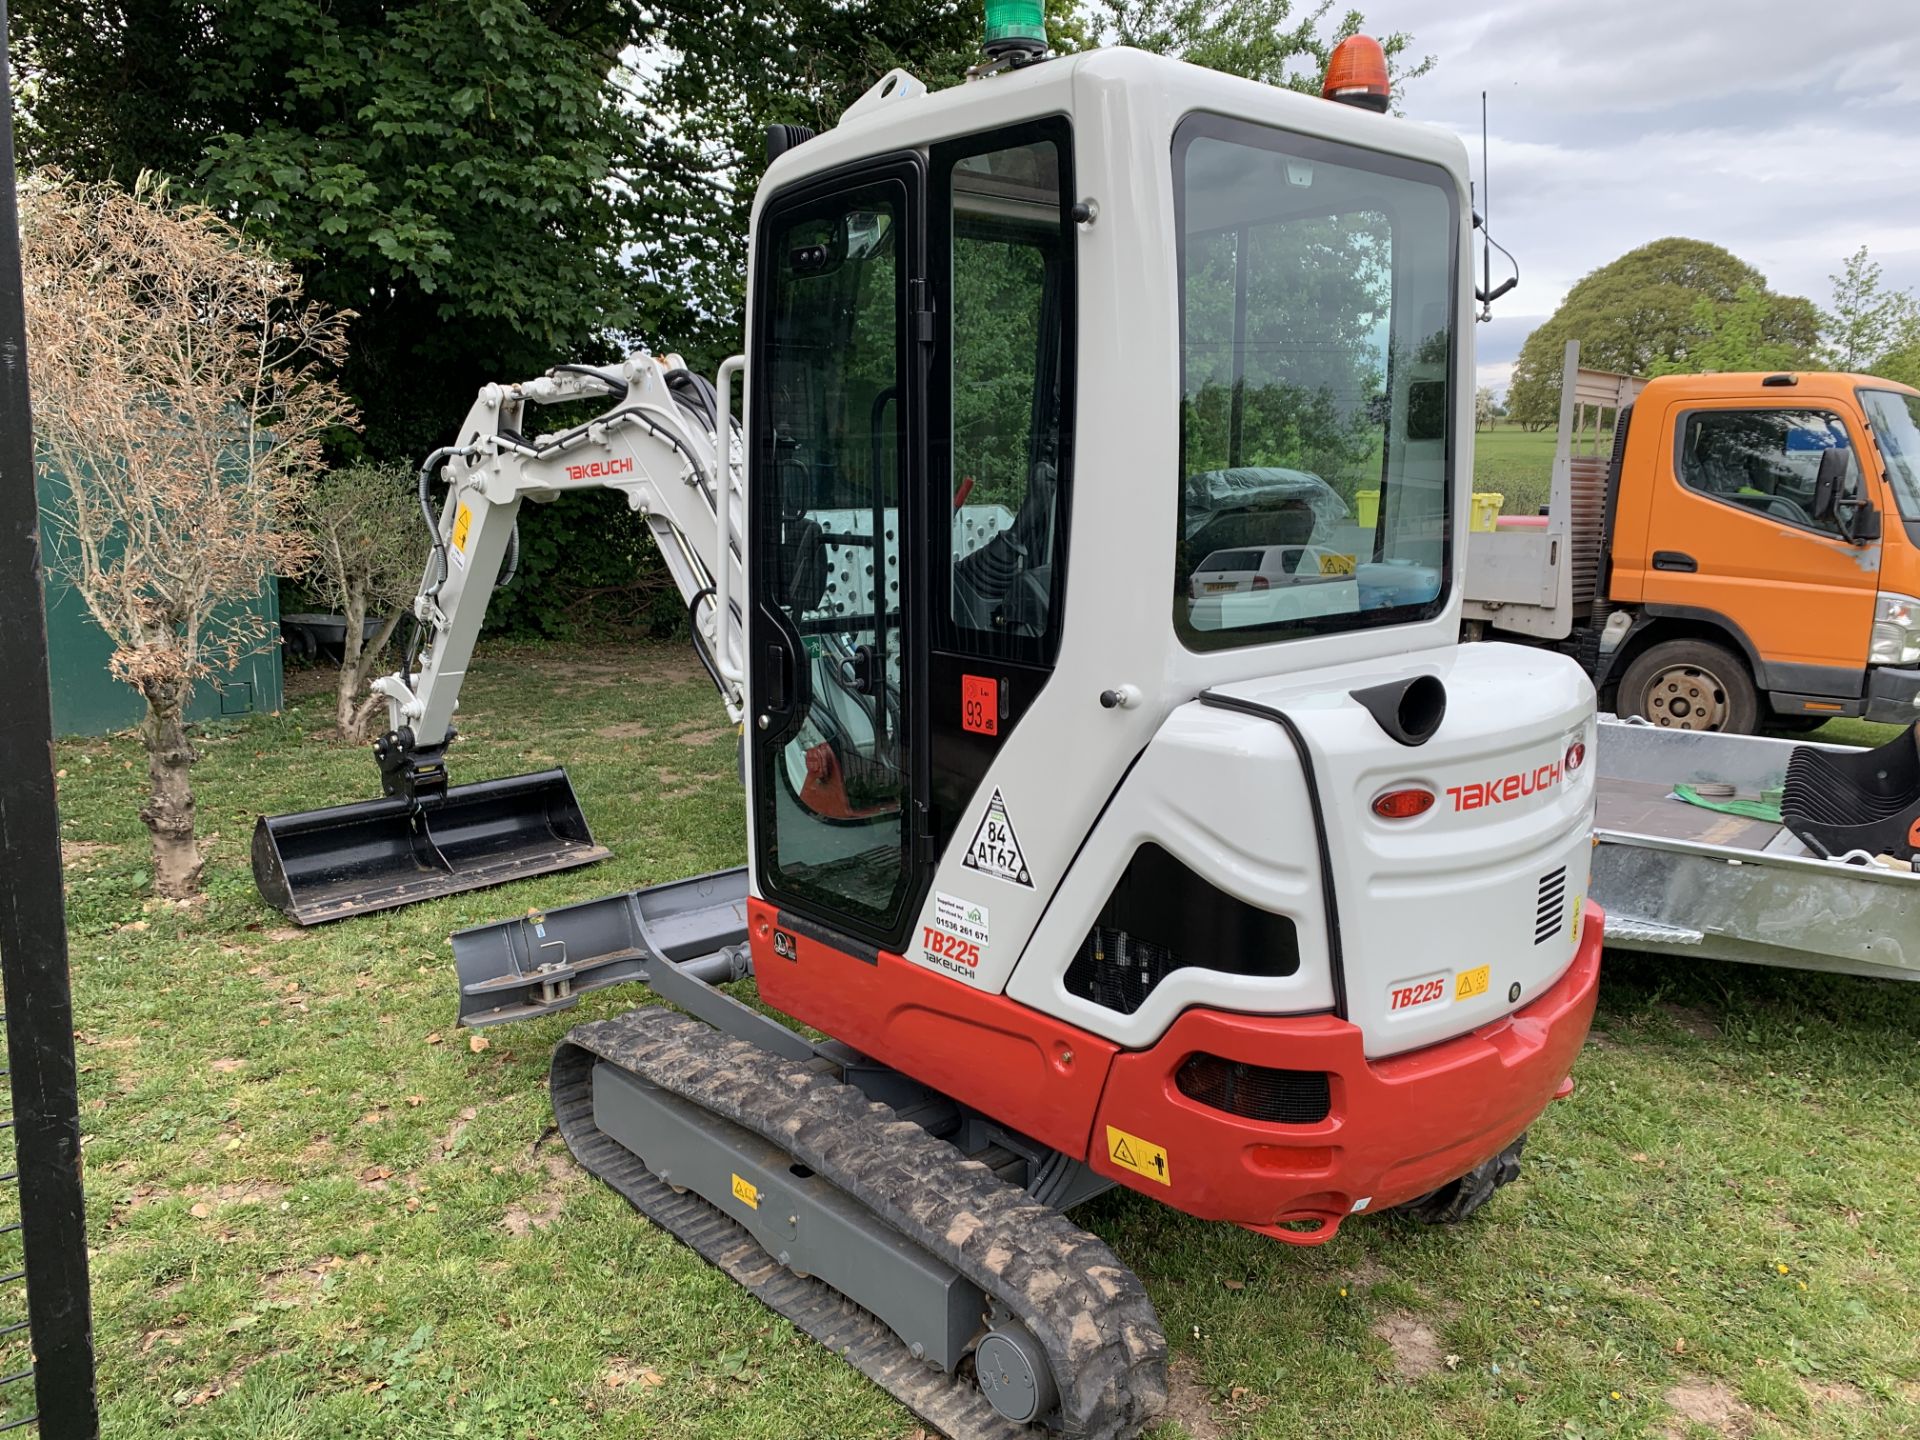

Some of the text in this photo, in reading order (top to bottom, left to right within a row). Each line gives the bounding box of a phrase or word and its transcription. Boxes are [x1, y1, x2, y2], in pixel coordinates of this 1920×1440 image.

[966, 700, 982, 728] 93
[988, 821, 1006, 845] 84
[978, 841, 1017, 874] AT6Z
[923, 926, 980, 968] TB225
[960, 925, 973, 937] 261
[974, 931, 989, 942] 671
[1391, 978, 1445, 1010] TB225
